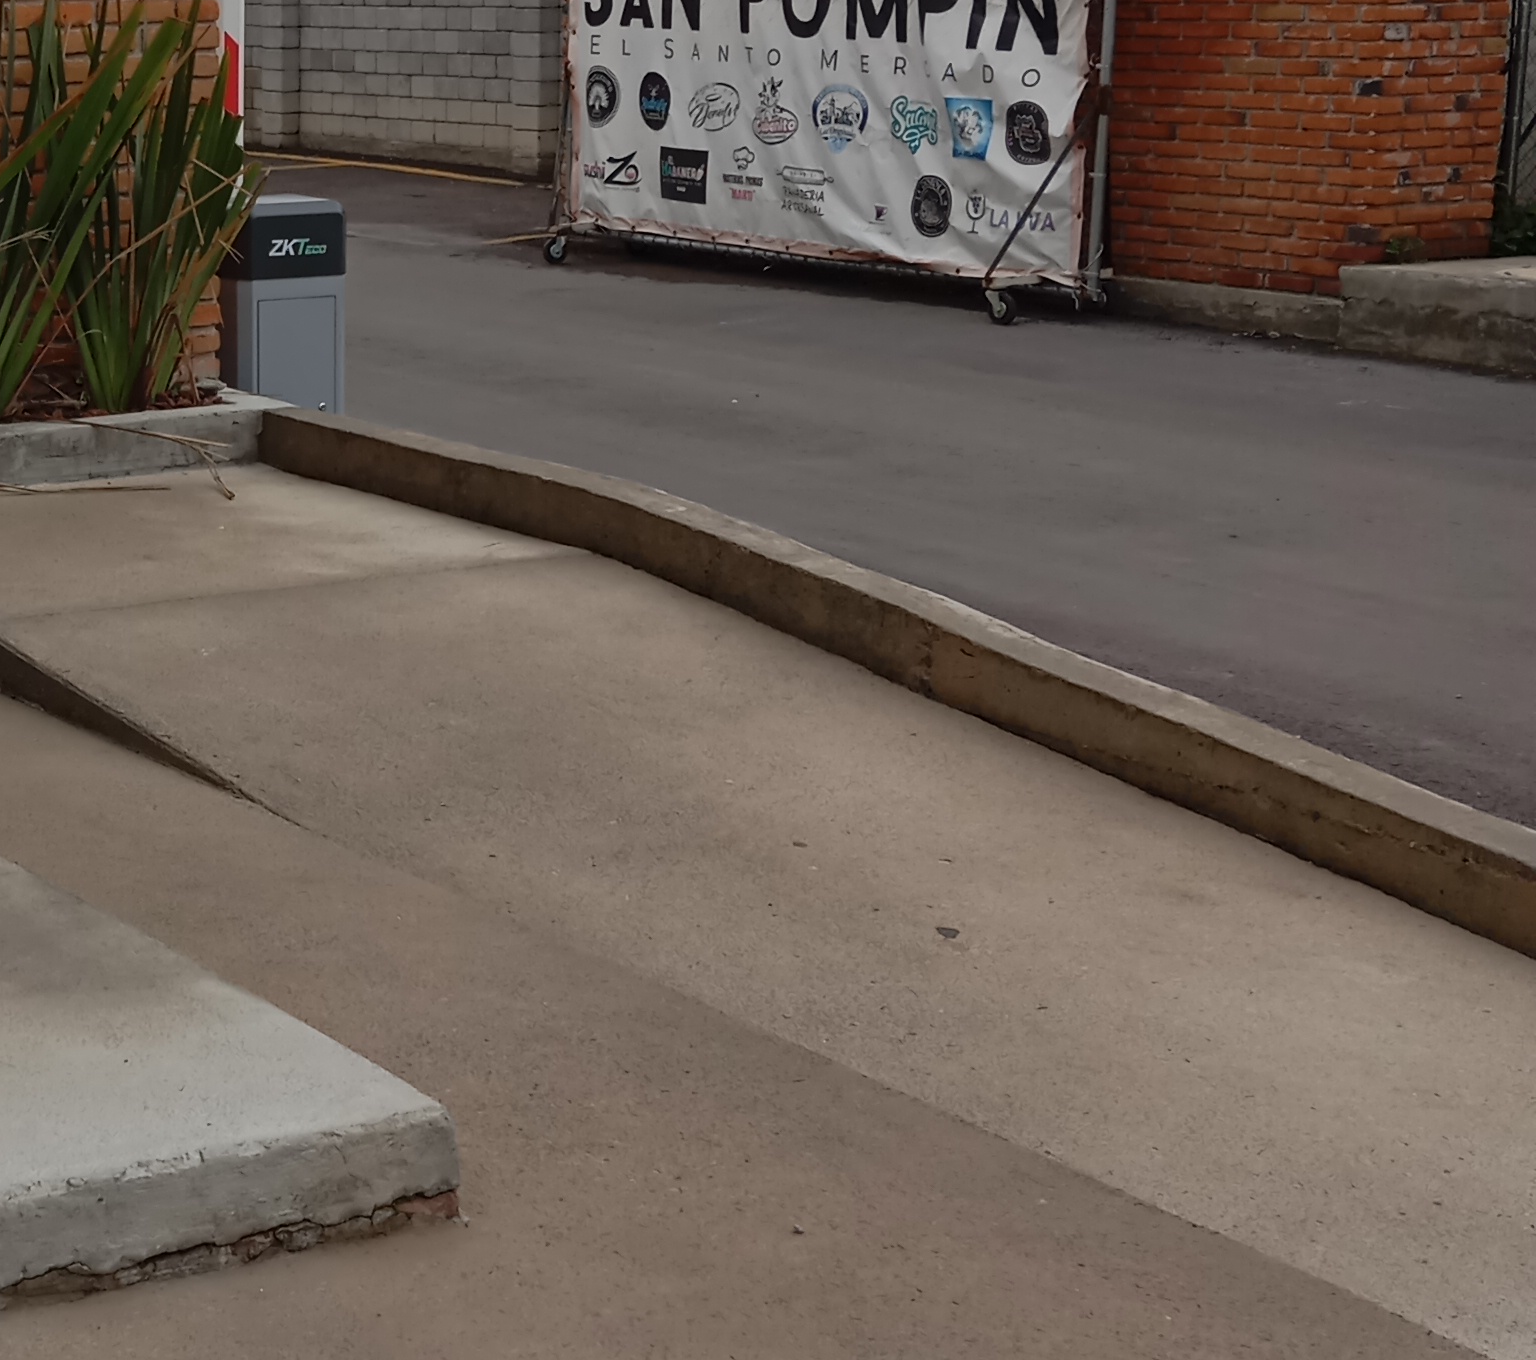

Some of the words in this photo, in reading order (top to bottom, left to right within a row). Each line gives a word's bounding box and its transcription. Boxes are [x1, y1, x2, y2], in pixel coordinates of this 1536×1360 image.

[590, 35, 631, 56] EL
[664, 38, 781, 66] SANTO
[583, 160, 606, 180] sushi
[989, 209, 1009, 228] LA
